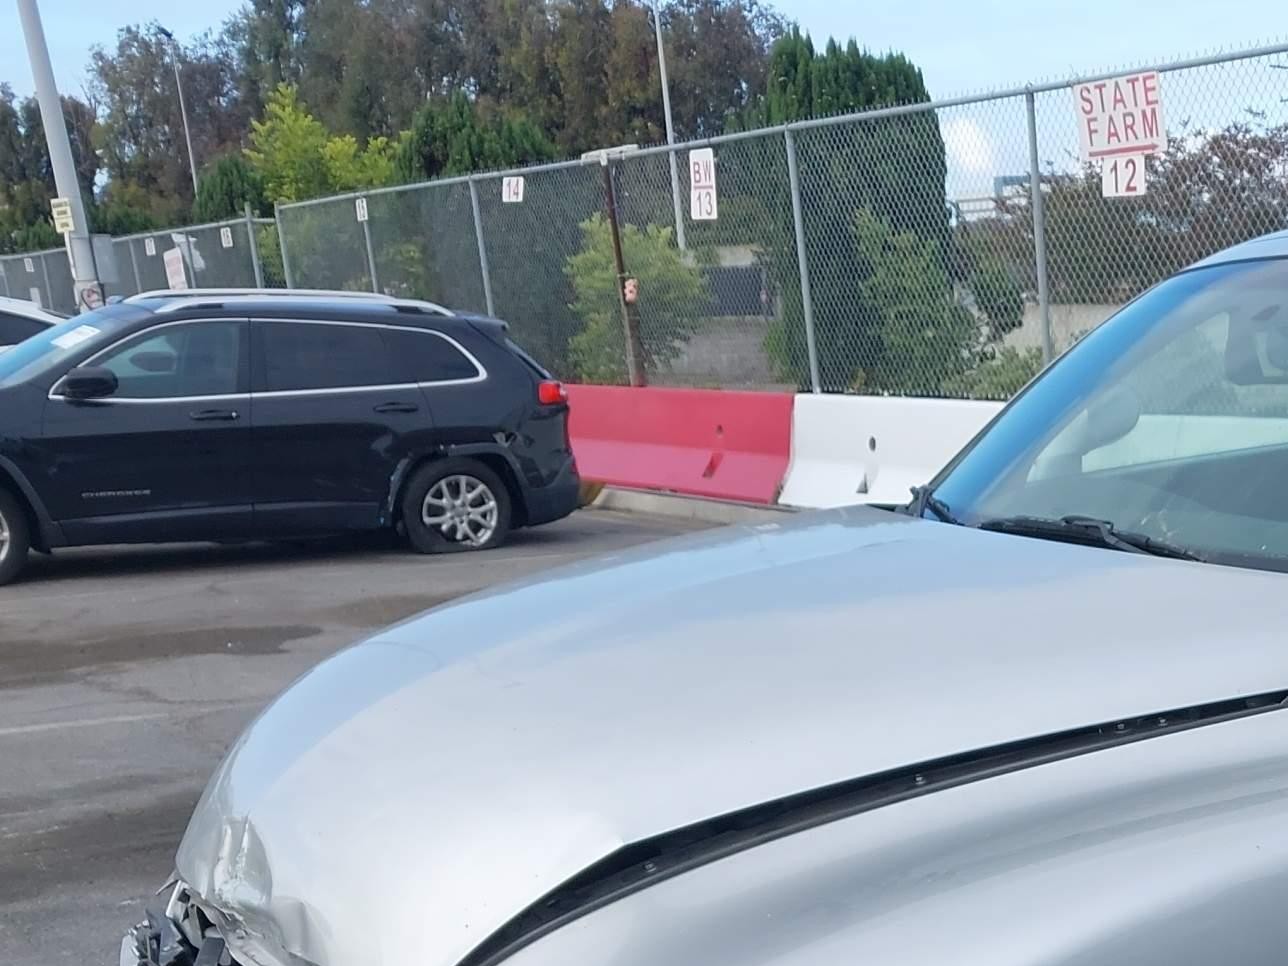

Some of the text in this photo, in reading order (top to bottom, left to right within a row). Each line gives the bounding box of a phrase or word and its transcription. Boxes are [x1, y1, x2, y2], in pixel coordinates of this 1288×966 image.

[1079, 74, 1159, 116] STATE
[1086, 107, 1159, 147] FARM
[693, 159, 712, 184] BW
[1110, 158, 1138, 193] 12
[506, 178, 520, 201] 14
[697, 191, 713, 217] 13
